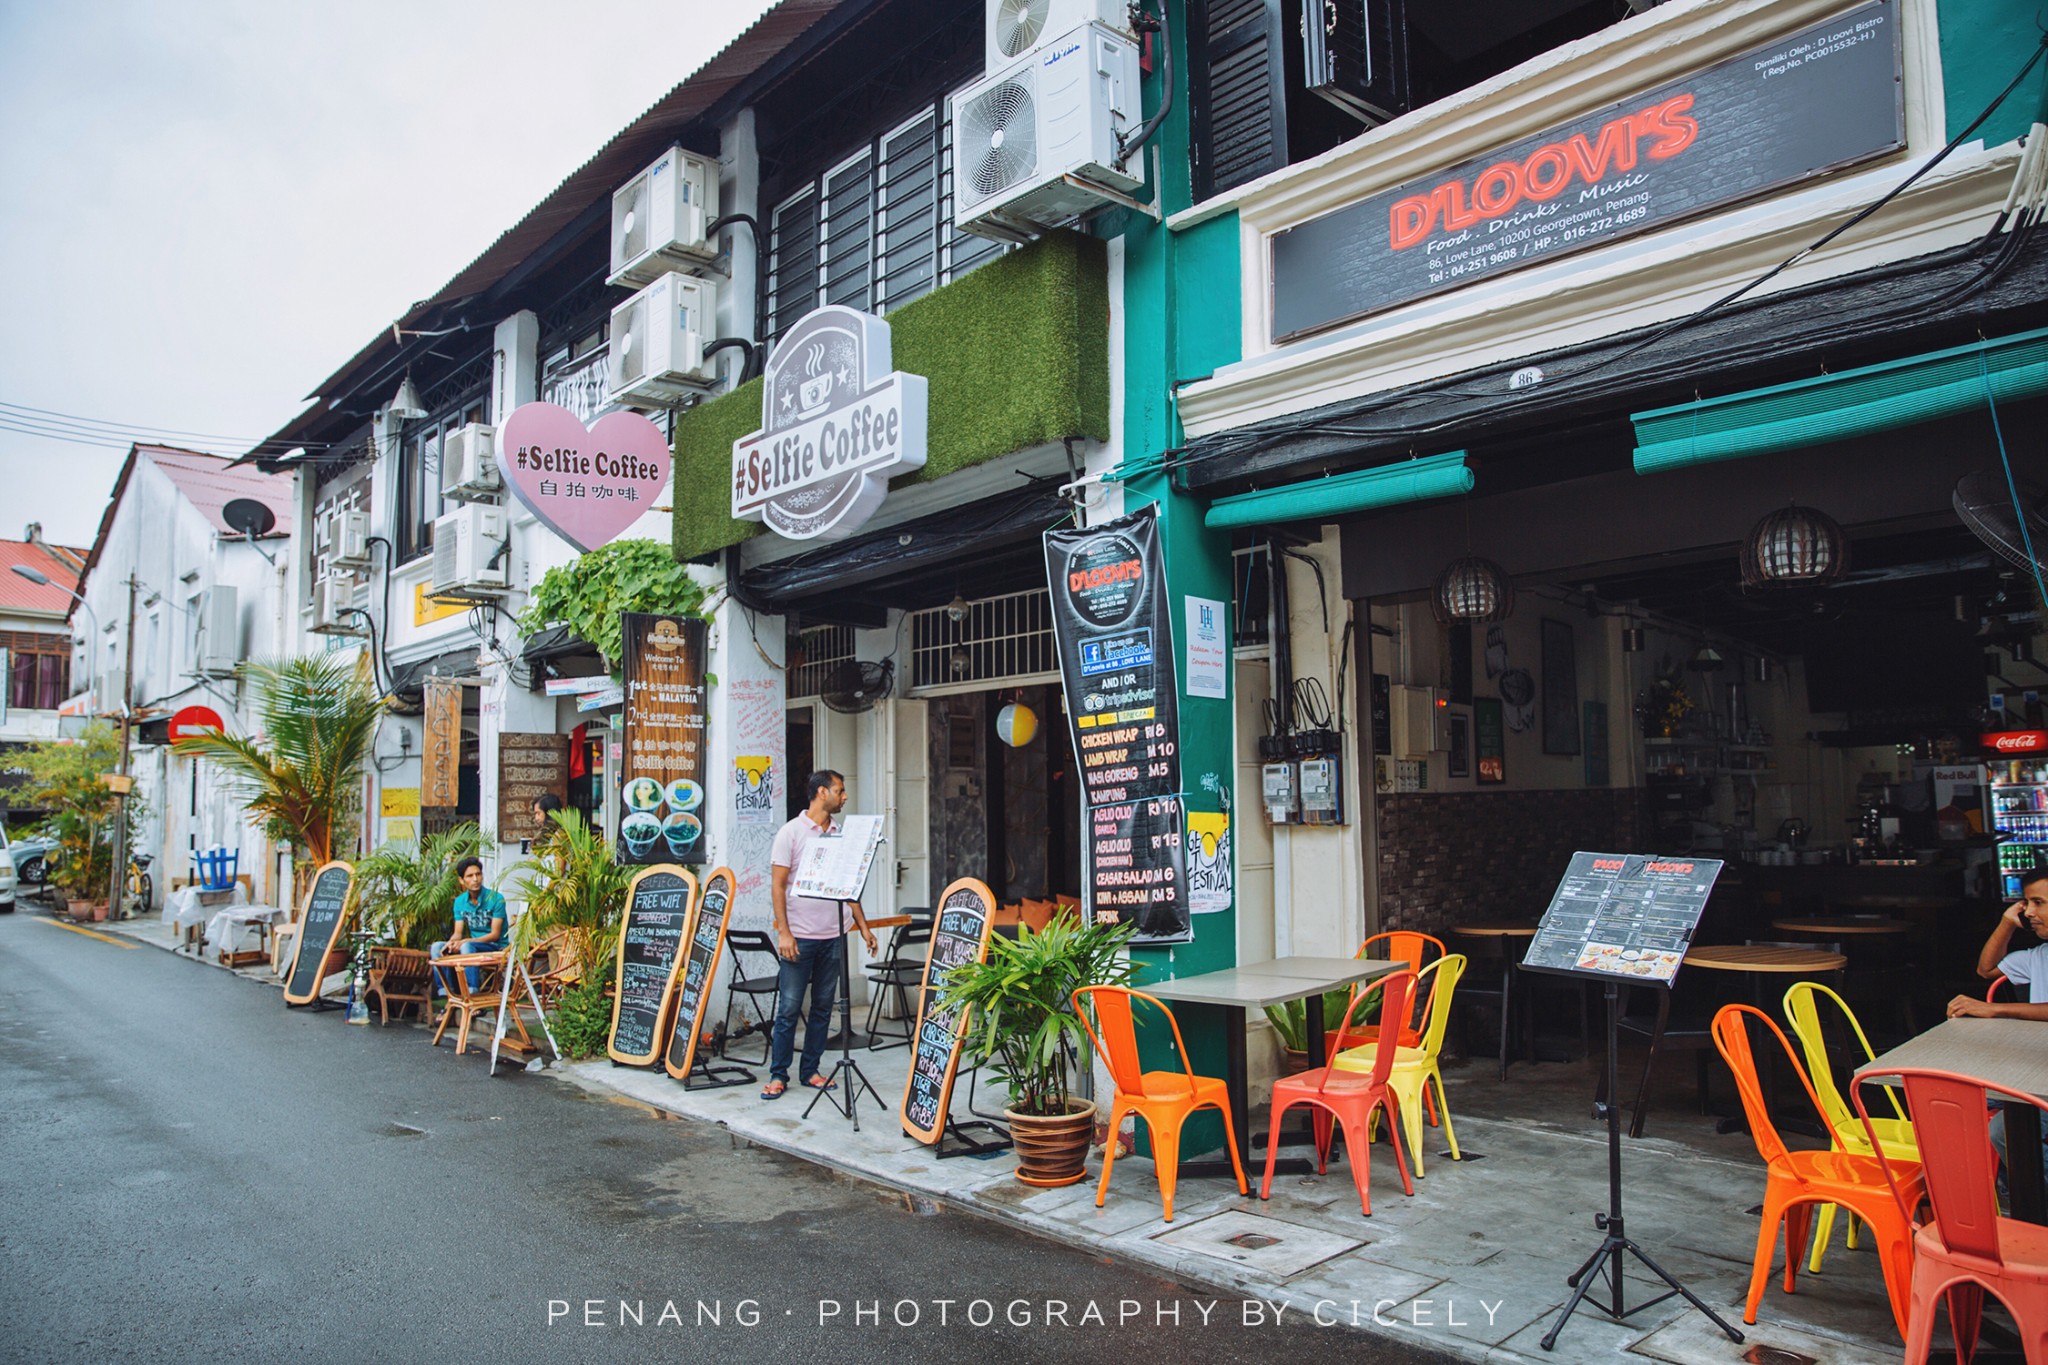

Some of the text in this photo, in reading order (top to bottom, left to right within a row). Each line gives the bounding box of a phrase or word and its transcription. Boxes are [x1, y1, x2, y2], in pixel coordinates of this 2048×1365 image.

[1754, 52, 1788, 71] Dimiliki
[1818, 38, 1826, 47] D
[1828, 26, 1853, 43] Loovi
[1856, 16, 1884, 32] Bistro
[1390, 93, 1699, 250] D'LOOVI'S
[1426, 173, 1650, 255] Food Drinks Music
[1445, 249, 1468, 265] Love
[1471, 242, 1496, 258] Lane,
[1500, 229, 1530, 248] 10200
[1533, 207, 1603, 241] Georgetown,
[1605, 190, 1652, 216] Penang.
[1451, 258, 1487, 278] 04-251
[1490, 248, 1517, 268] 9608
[1563, 218, 1613, 242] 016-272
[1615, 205, 1647, 226] 4689
[1518, 371, 1533, 385] 86
[735, 404, 899, 500] #Selfie Coffee
[517, 445, 659, 481] #Selfie Coffee
[540, 479, 639, 501] 自拍咖啡
[1069, 559, 1142, 593] D'LOOVI'S
[644, 653, 684, 664] Welcome To
[1122, 656, 1135, 666] LOVE
[1136, 653, 1152, 663] LANE
[659, 692, 698, 704] MALAYSIA
[1081, 731, 1113, 749] CHICKEN
[1113, 727, 1139, 744] WRAP
[1156, 723, 1166, 737] 8
[1084, 752, 1104, 767] LAMB
[1104, 748, 1128, 765] WRAP
[1158, 742, 1175, 757] 10
[1104, 766, 1139, 784] GORENG
[1160, 762, 1169, 776] 5
[1935, 770, 1977, 780] Red Bull
[736, 793, 772, 810] FESTIVAL
[1090, 787, 1127, 804] KAMPUNG
[1162, 800, 1178, 814] 10
[1162, 833, 1180, 847] 15
[1124, 869, 1153, 885] SALAD
[1164, 867, 1174, 881] 6
[1188, 867, 1232, 893] FESTIVAL
[635, 894, 682, 909] FREE WIFI
[1118, 889, 1149, 904] ASSAM
[1152, 888, 1165, 903] RM
[1166, 886, 1176, 902] 3
[941, 913, 982, 937] FREE WIFI
[1096, 910, 1120, 924] DRINK
[936, 934, 954, 952] HAPPY
[941, 950, 954, 964] ALL
[918, 1042, 934, 1057] HALF
[914, 1074, 932, 1095] TIGER
[916, 1091, 938, 1114] TOWER
